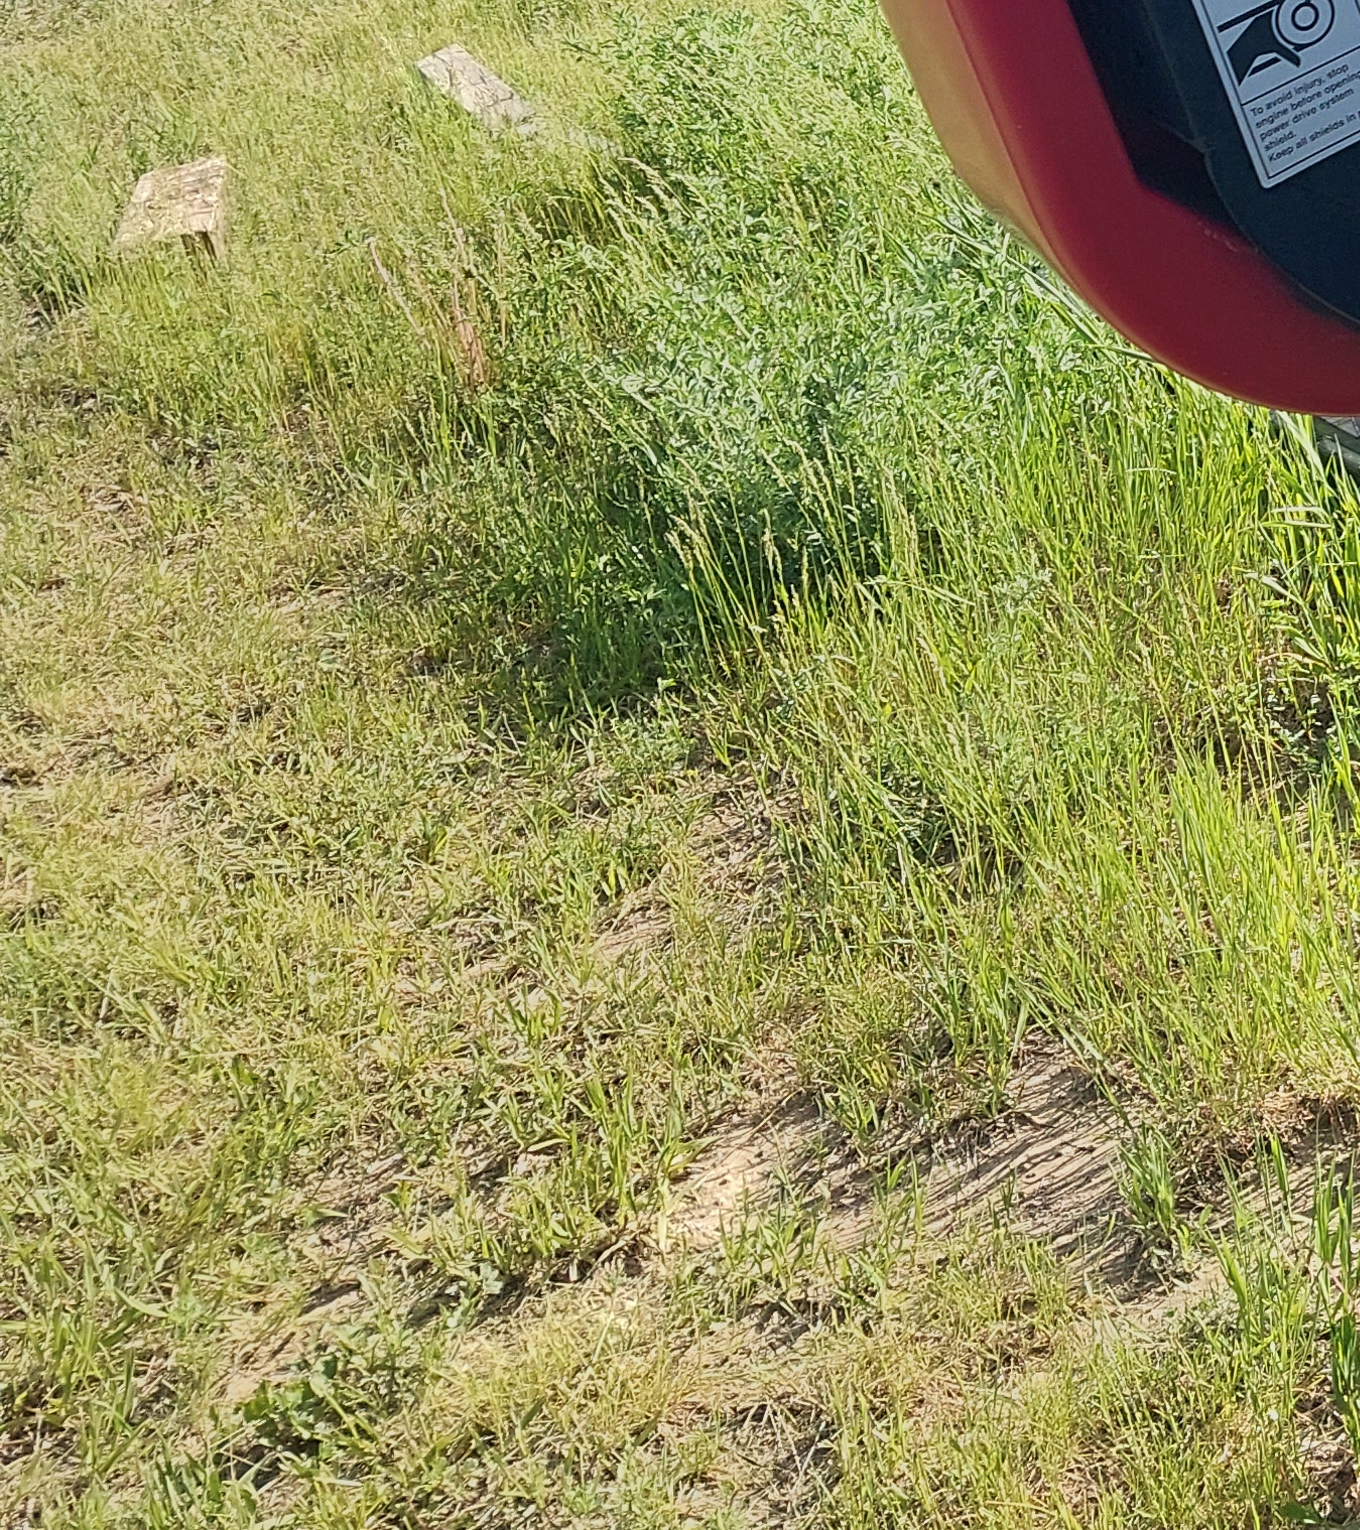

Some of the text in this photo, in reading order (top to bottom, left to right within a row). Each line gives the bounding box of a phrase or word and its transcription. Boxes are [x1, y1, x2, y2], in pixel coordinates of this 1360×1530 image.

[1250, 105, 1263, 117] To
[1265, 91, 1293, 110] avoid
[1326, 63, 1349, 81] stop
[1255, 107, 1289, 129] engine
[1290, 89, 1322, 111] before
[1259, 87, 1354, 142] power drive system
[1263, 130, 1297, 152] shield.
[1268, 145, 1294, 164] Keep
[1295, 138, 1307, 149] all
[1309, 119, 1345, 143] shields
[1346, 113, 1357, 123] in
